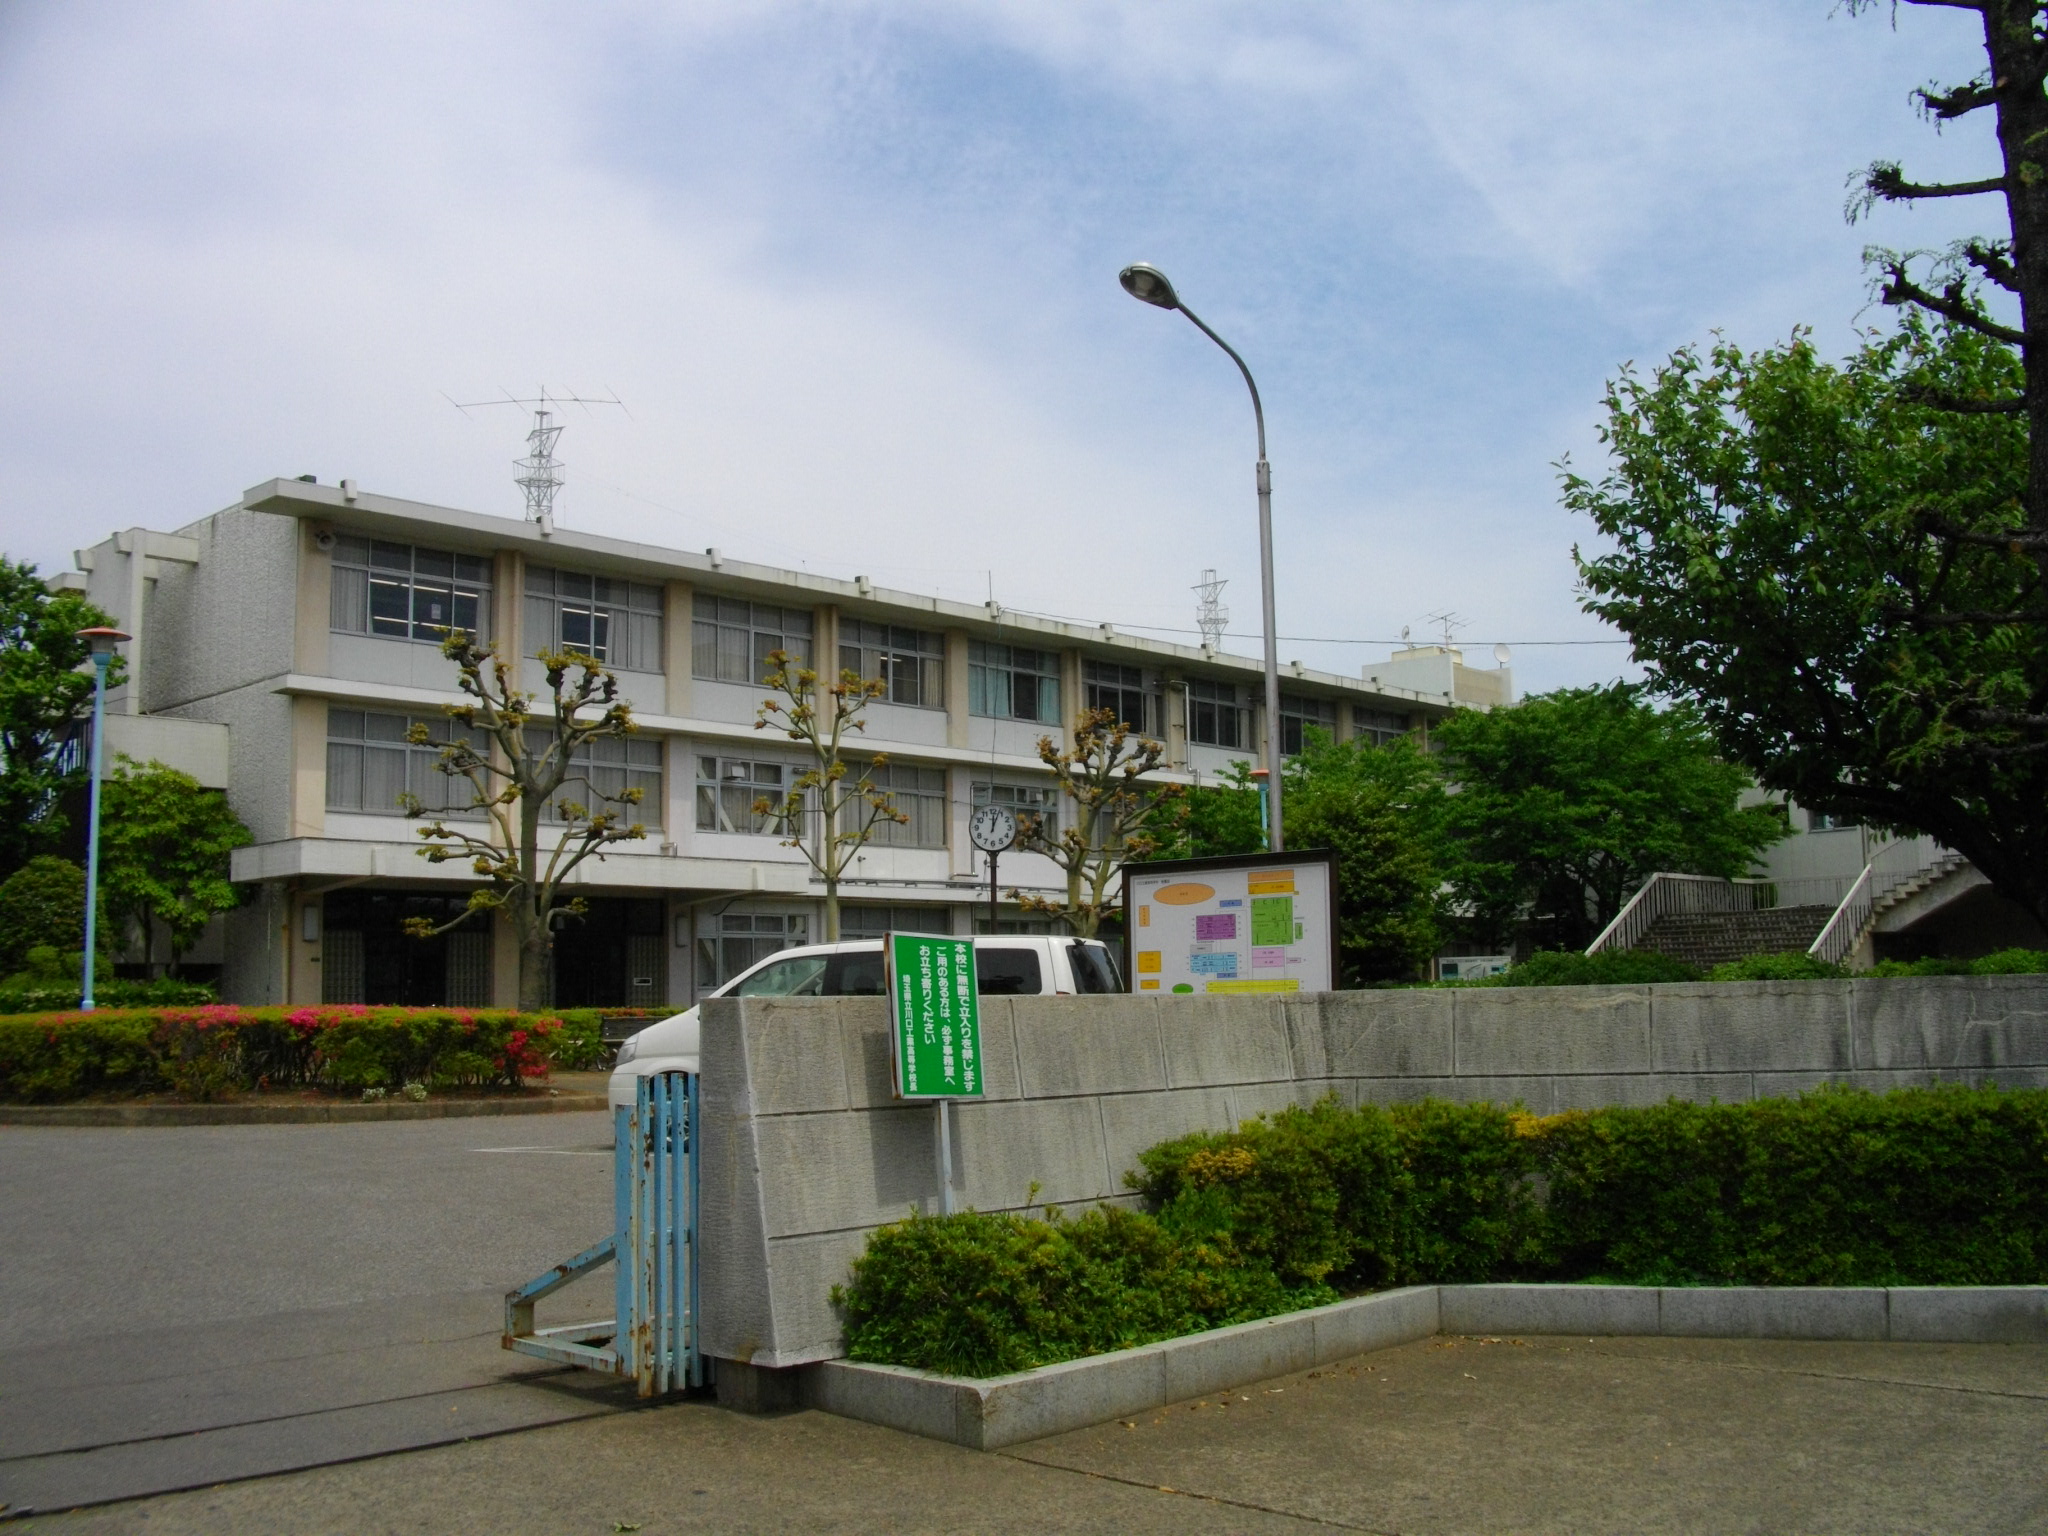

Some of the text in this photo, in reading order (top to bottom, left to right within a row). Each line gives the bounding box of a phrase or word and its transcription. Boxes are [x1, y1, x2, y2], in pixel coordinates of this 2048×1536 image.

[919, 945, 936, 1045] お立ち寄りください
[936, 946, 956, 1086] ご用のある方は、必ず事務室へ
[954, 943, 975, 1092] 本校に無断で立入りを禁じます
